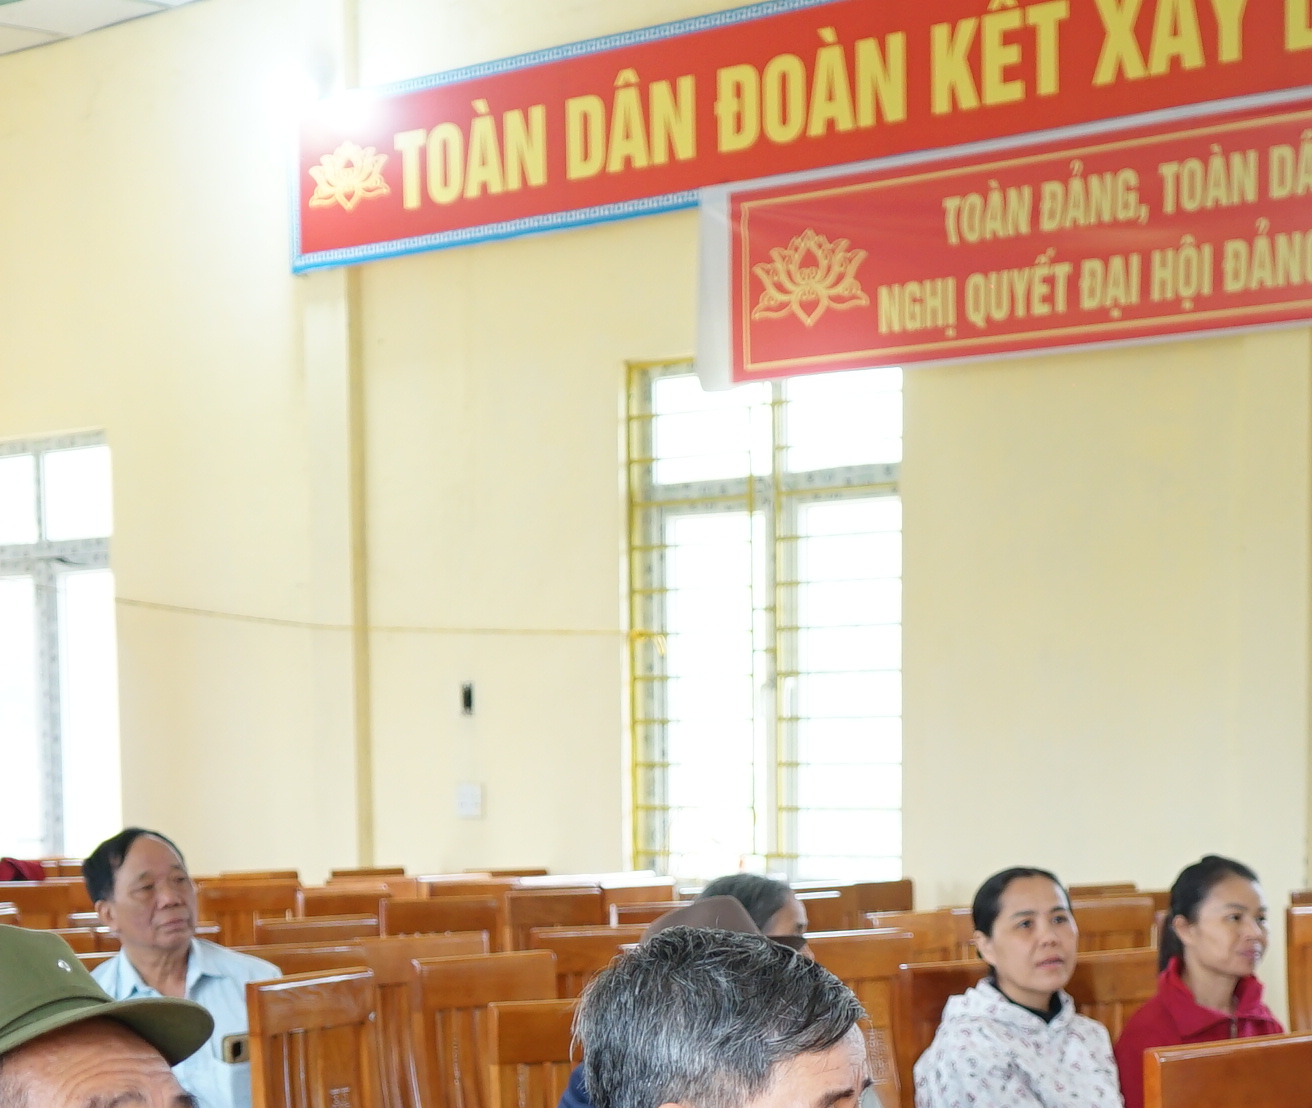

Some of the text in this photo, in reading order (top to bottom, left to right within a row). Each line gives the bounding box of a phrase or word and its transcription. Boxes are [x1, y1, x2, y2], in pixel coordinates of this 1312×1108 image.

[393, 98, 548, 210] TOÀN
[565, 67, 697, 182] DÂN
[714, 26, 908, 154] ĐOÀN
[942, 179, 1033, 246] TOÀN
[1038, 158, 1151, 232] ĐẢNG,
[1158, 142, 1259, 216] TOÀN
[877, 276, 957, 337] NGHỊ
[964, 247, 1074, 328] QUYẾT
[1078, 252, 1142, 319] ĐẠI
[1149, 235, 1215, 311] HỘI
